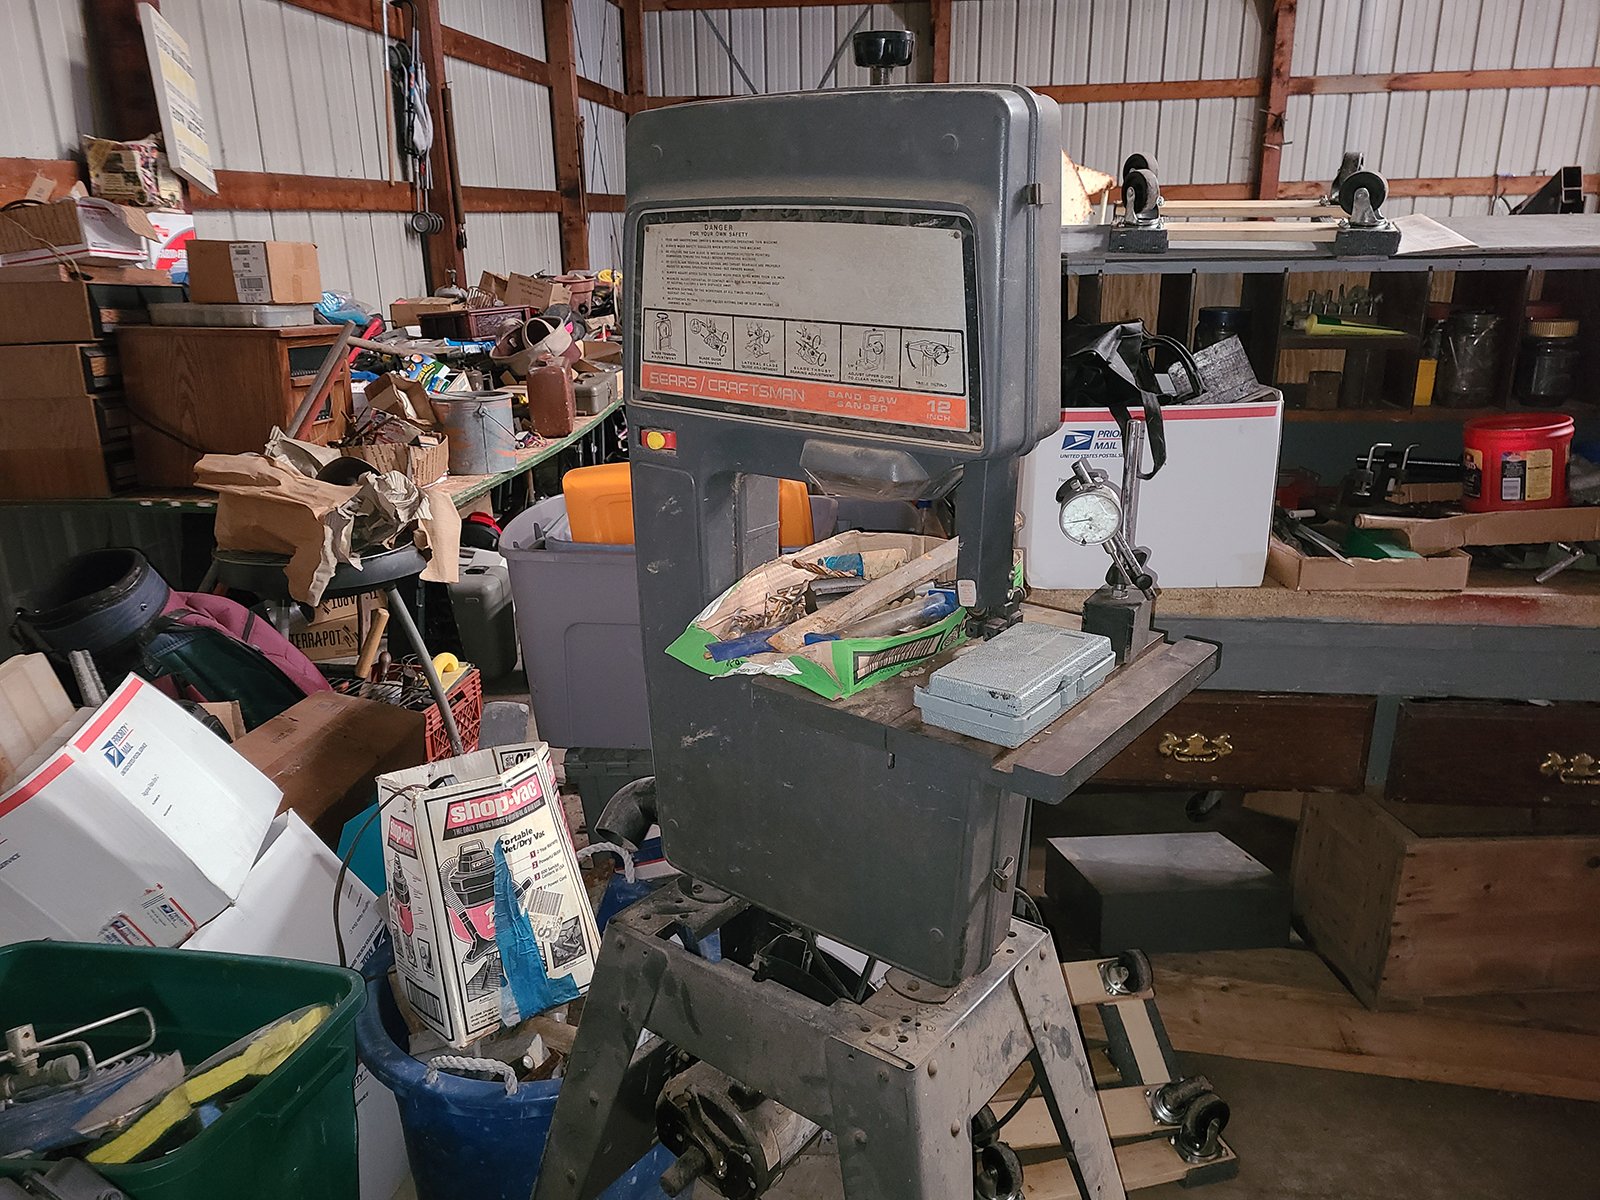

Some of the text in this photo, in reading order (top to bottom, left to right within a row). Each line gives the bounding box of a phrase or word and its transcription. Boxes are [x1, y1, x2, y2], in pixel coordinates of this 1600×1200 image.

[827, 390, 897, 405] BAND SAW
[837, 401, 888, 412] SANDER
[927, 401, 951, 414] 12
[533, 830, 545, 840] Vac
